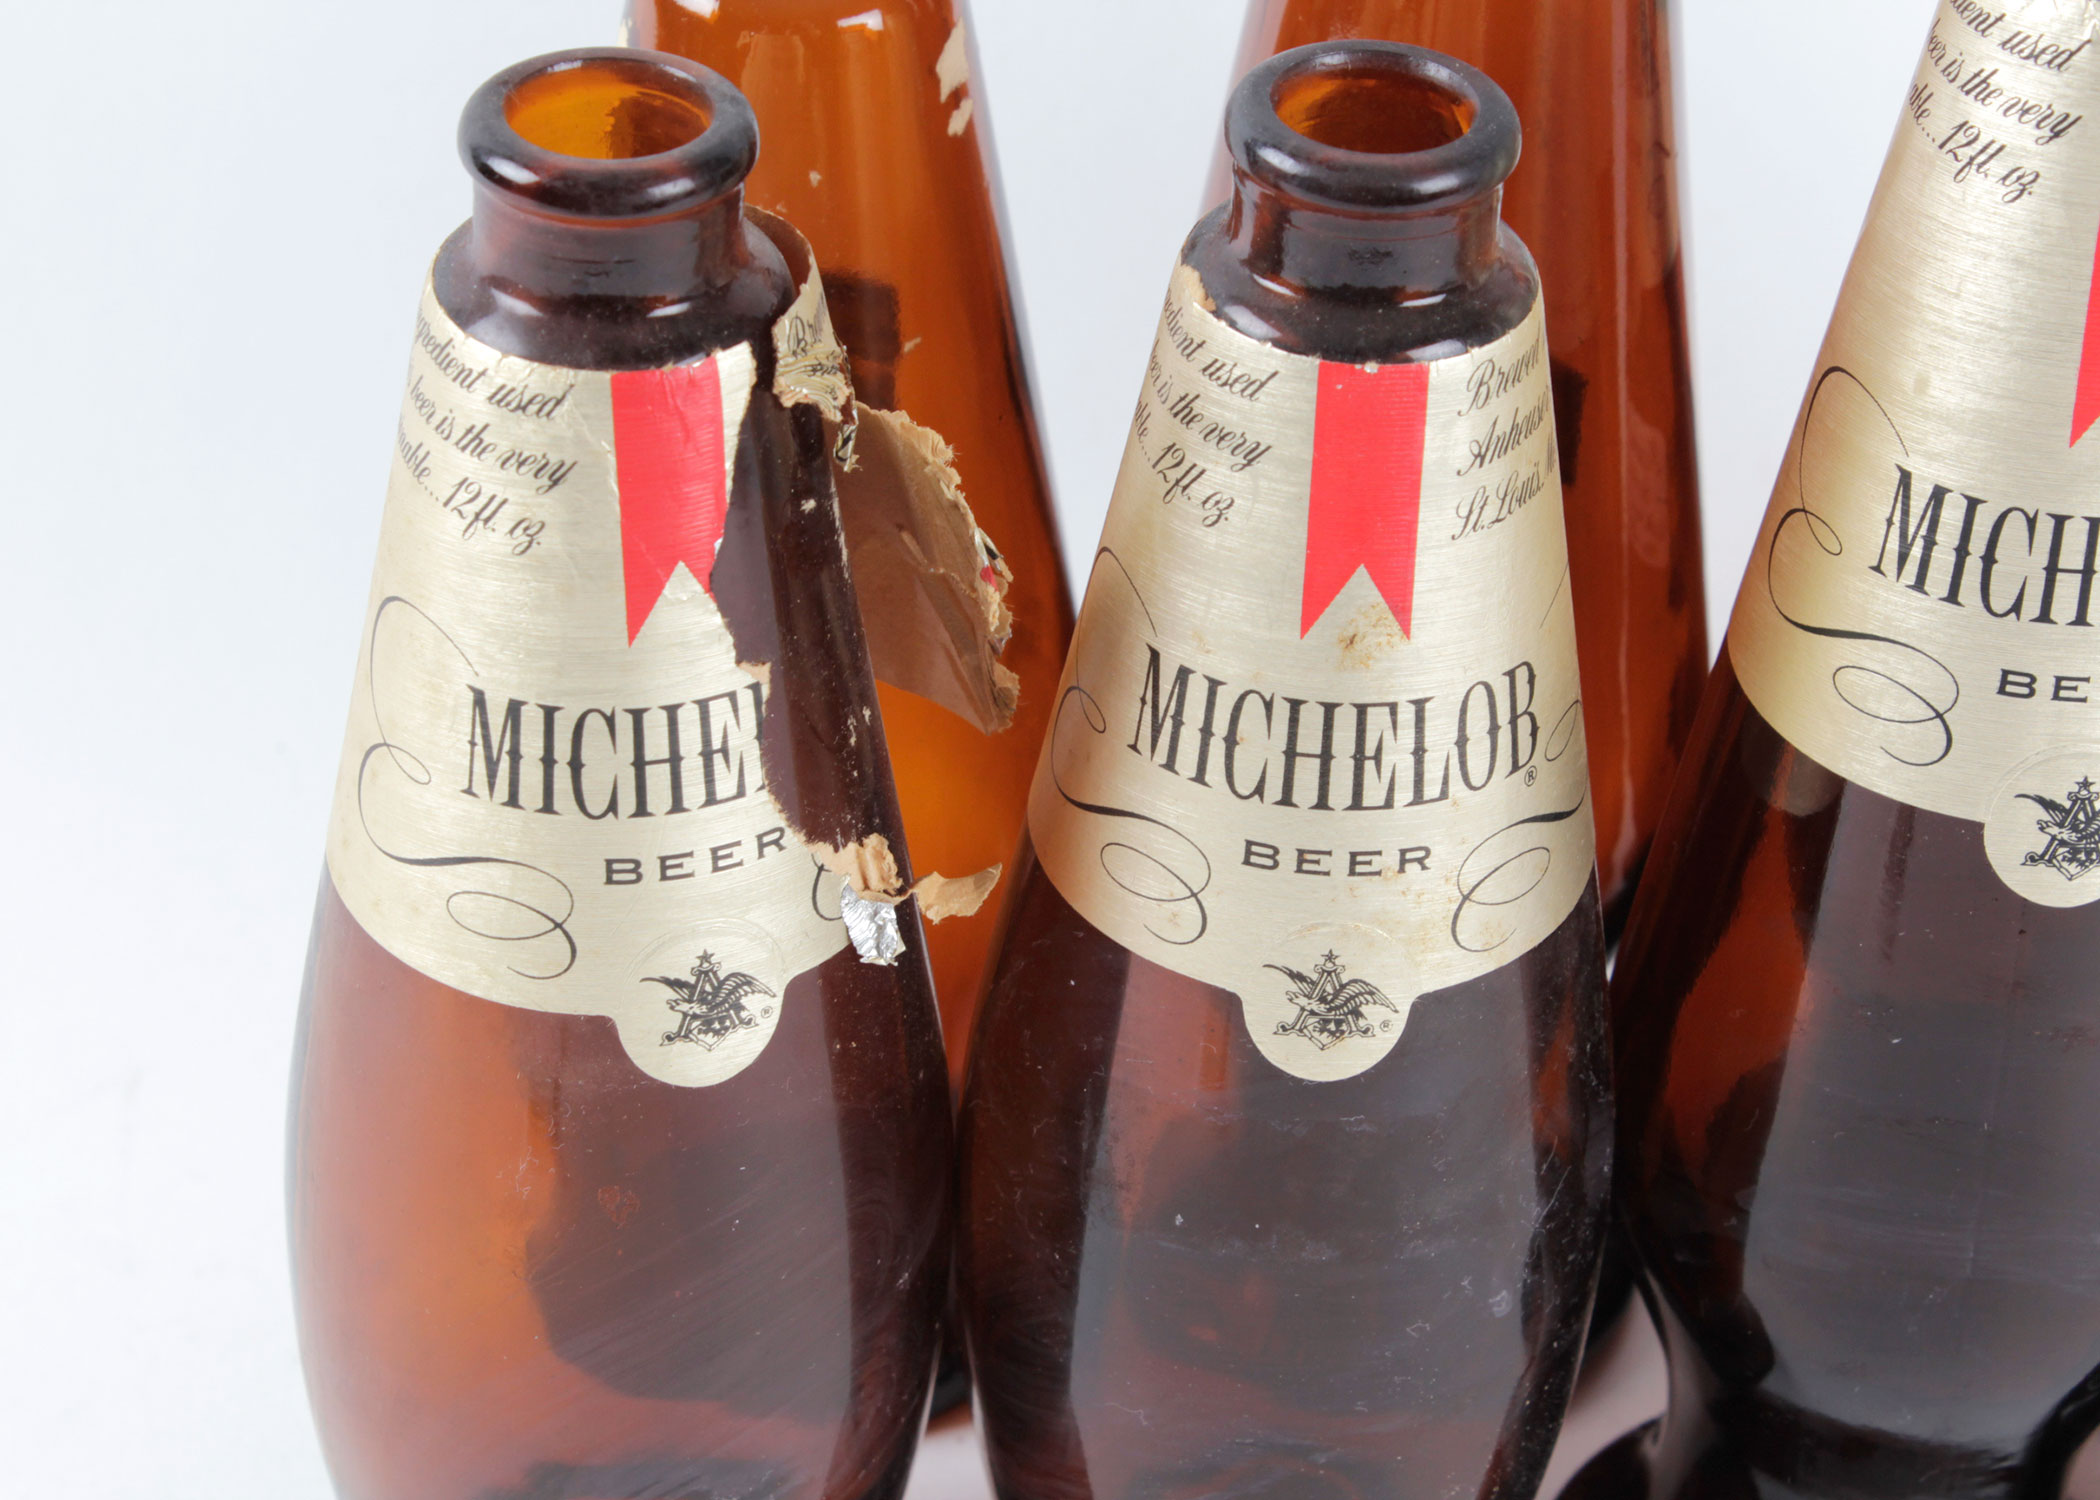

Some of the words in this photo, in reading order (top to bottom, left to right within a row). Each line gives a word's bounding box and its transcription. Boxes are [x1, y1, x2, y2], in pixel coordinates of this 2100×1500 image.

[1998, 29, 2093, 73] used
[1941, 51, 1965, 84] is
[1957, 67, 2004, 106] the
[1996, 96, 2084, 146] very
[1996, 166, 2040, 204] oz.
[1201, 356, 1279, 402] used
[486, 384, 576, 421] used
[1156, 374, 1173, 405] is
[1168, 393, 1204, 431] the
[1199, 422, 1272, 472] very
[409, 373, 437, 425] beer
[434, 408, 455, 441] is
[455, 423, 497, 464] the
[495, 449, 578, 495] very
[1201, 491, 1236, 527] oz.
[1451, 485, 1489, 541] St.
[505, 517, 546, 556] oz.
[1868, 462, 2100, 627] MICH
[1994, 667, 2092, 703] BE
[1126, 642, 1541, 813] MICHELOB
[603, 826, 787, 887] BEER
[1240, 838, 1432, 878] BEER
